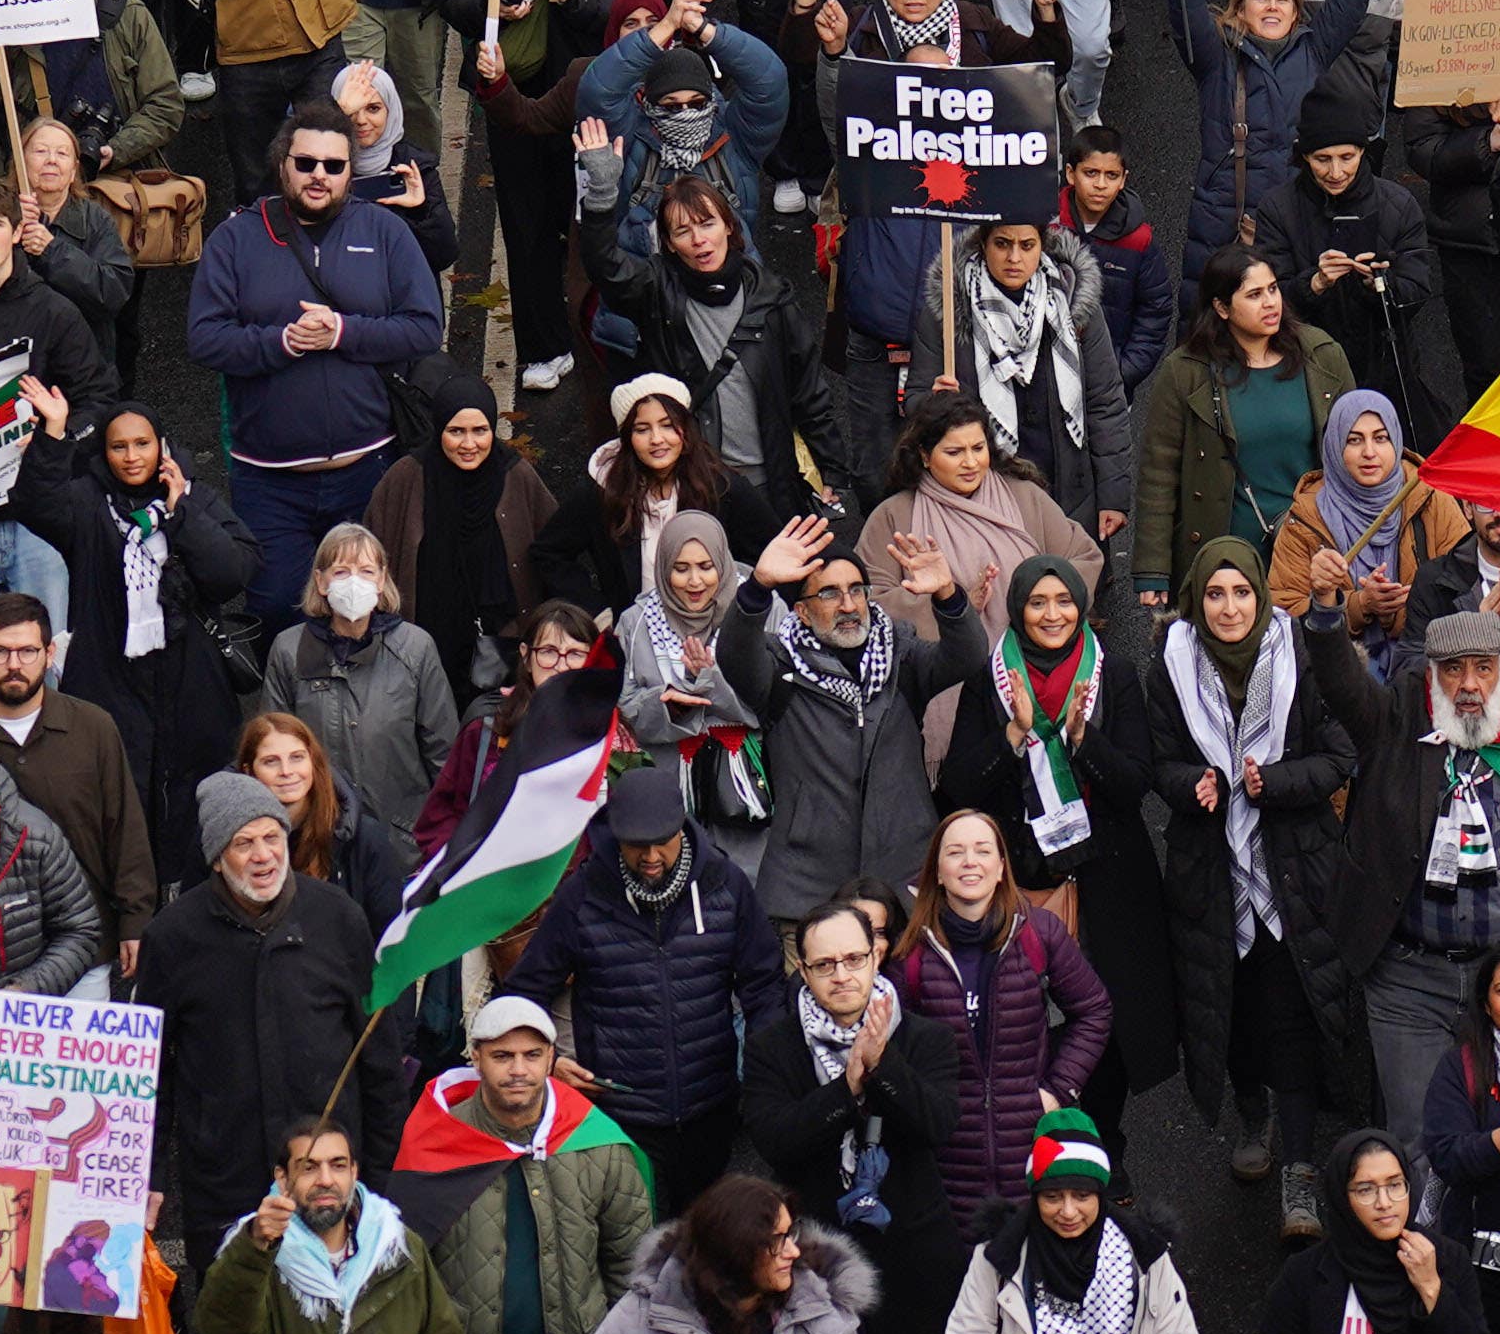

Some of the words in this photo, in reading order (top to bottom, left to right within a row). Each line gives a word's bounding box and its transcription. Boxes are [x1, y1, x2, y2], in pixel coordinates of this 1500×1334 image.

[895, 75, 993, 121] Free
[845, 115, 1048, 167] Palestine
[6, 999, 73, 1031] NEVER
[87, 1007, 162, 1039] AGAIN
[60, 1035, 156, 1068] ENOUGH
[108, 1104, 148, 1123] CALL
[109, 1132, 143, 1149] FOR
[85, 1154, 141, 1173] CEASE
[82, 1178, 143, 1201] FIRE?
